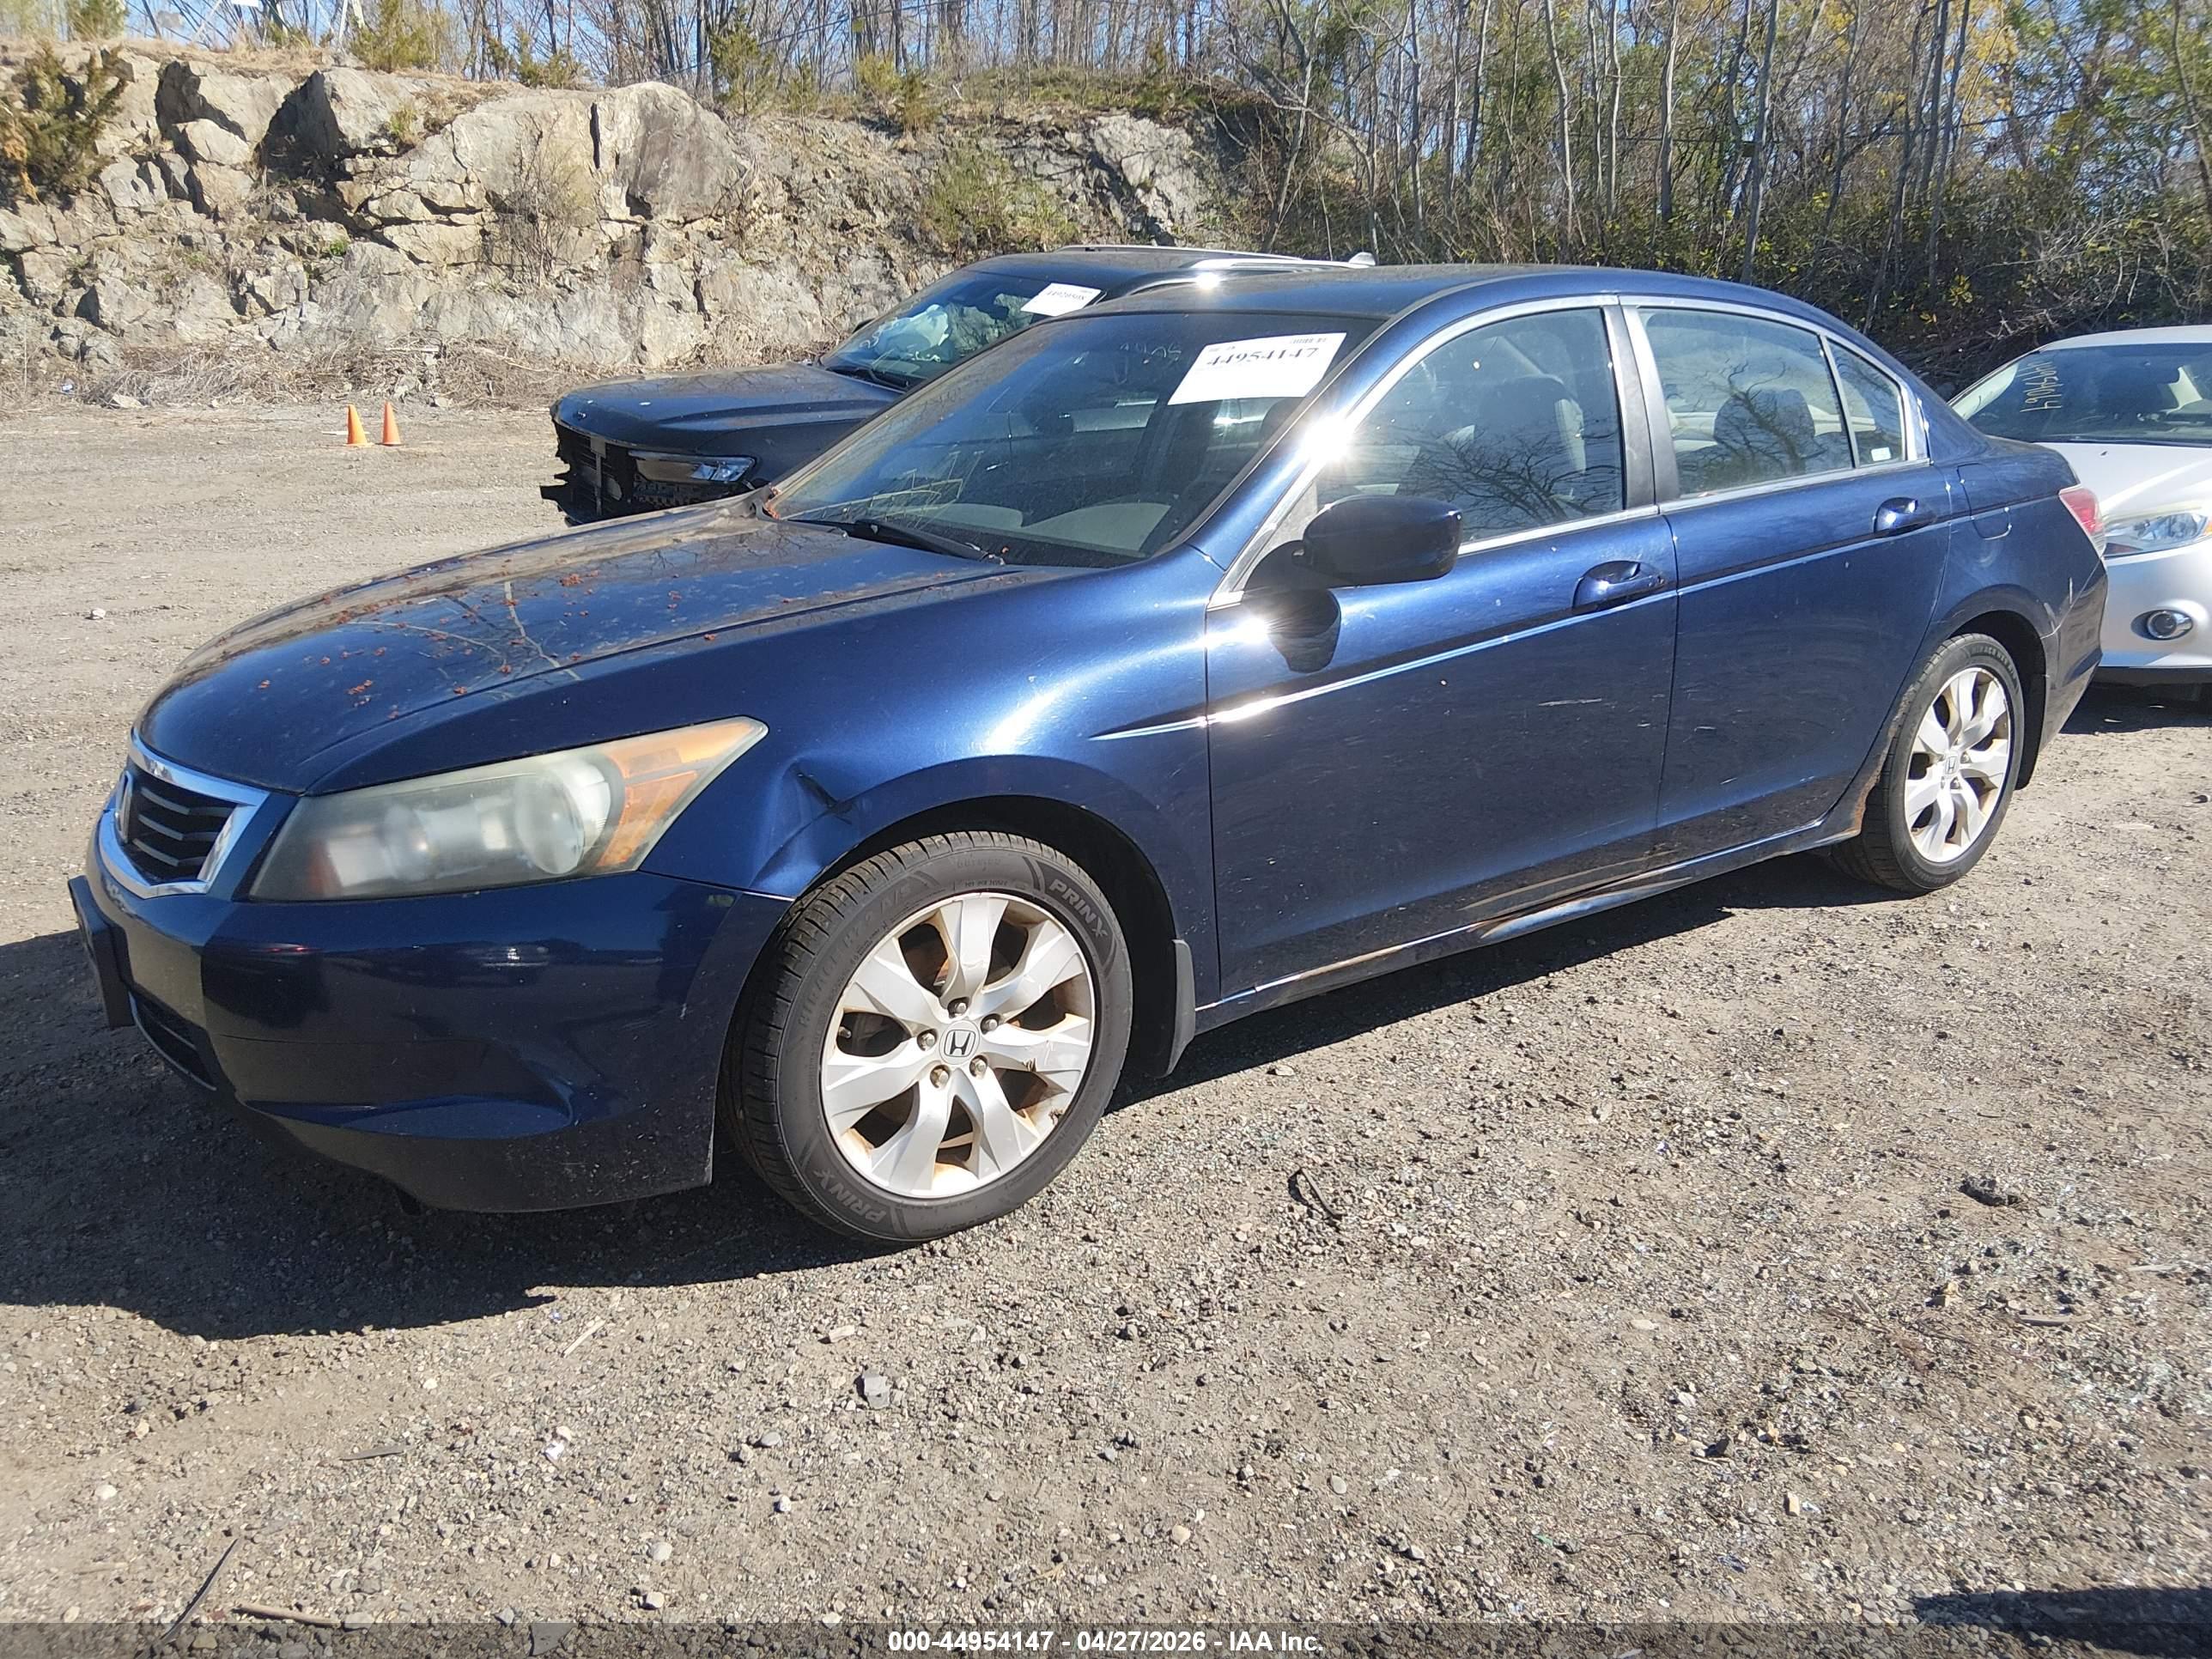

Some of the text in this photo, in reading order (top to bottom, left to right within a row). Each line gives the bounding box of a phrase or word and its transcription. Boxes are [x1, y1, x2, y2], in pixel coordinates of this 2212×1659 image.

[1206, 347, 1321, 367] 44954147
[1048, 878, 1109, 939] PRINX
[814, 1169, 887, 1224] PRINX
